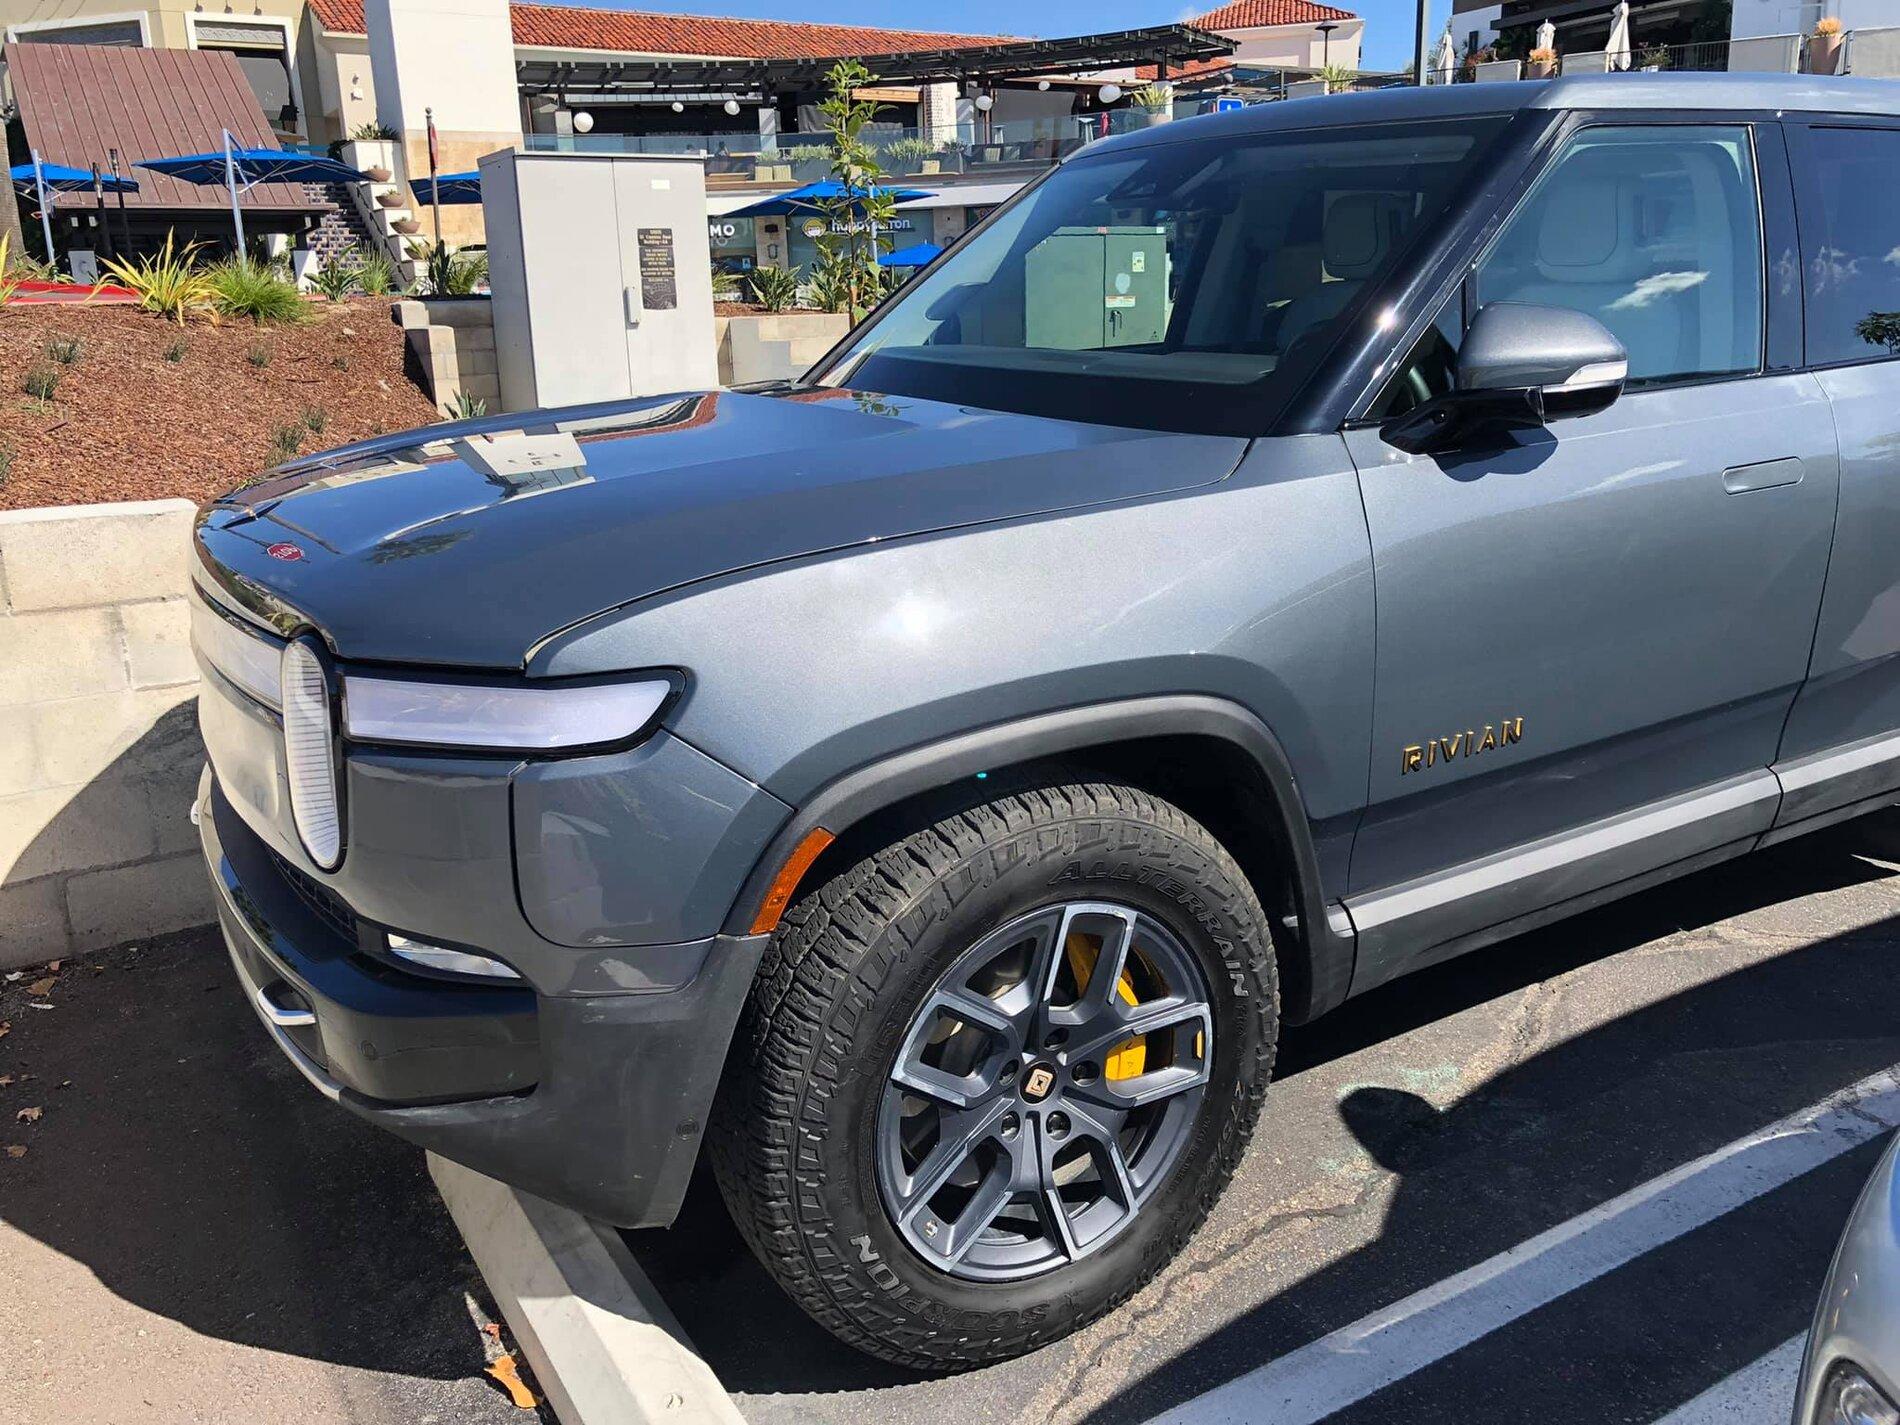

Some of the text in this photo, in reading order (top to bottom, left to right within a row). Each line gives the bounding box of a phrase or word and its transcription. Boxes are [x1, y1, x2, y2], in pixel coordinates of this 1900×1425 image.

[1403, 717, 1524, 775] RIVIAN
[1047, 859, 1251, 998] ALL TERRAIN
[848, 1232, 1051, 1332] SCORPION
